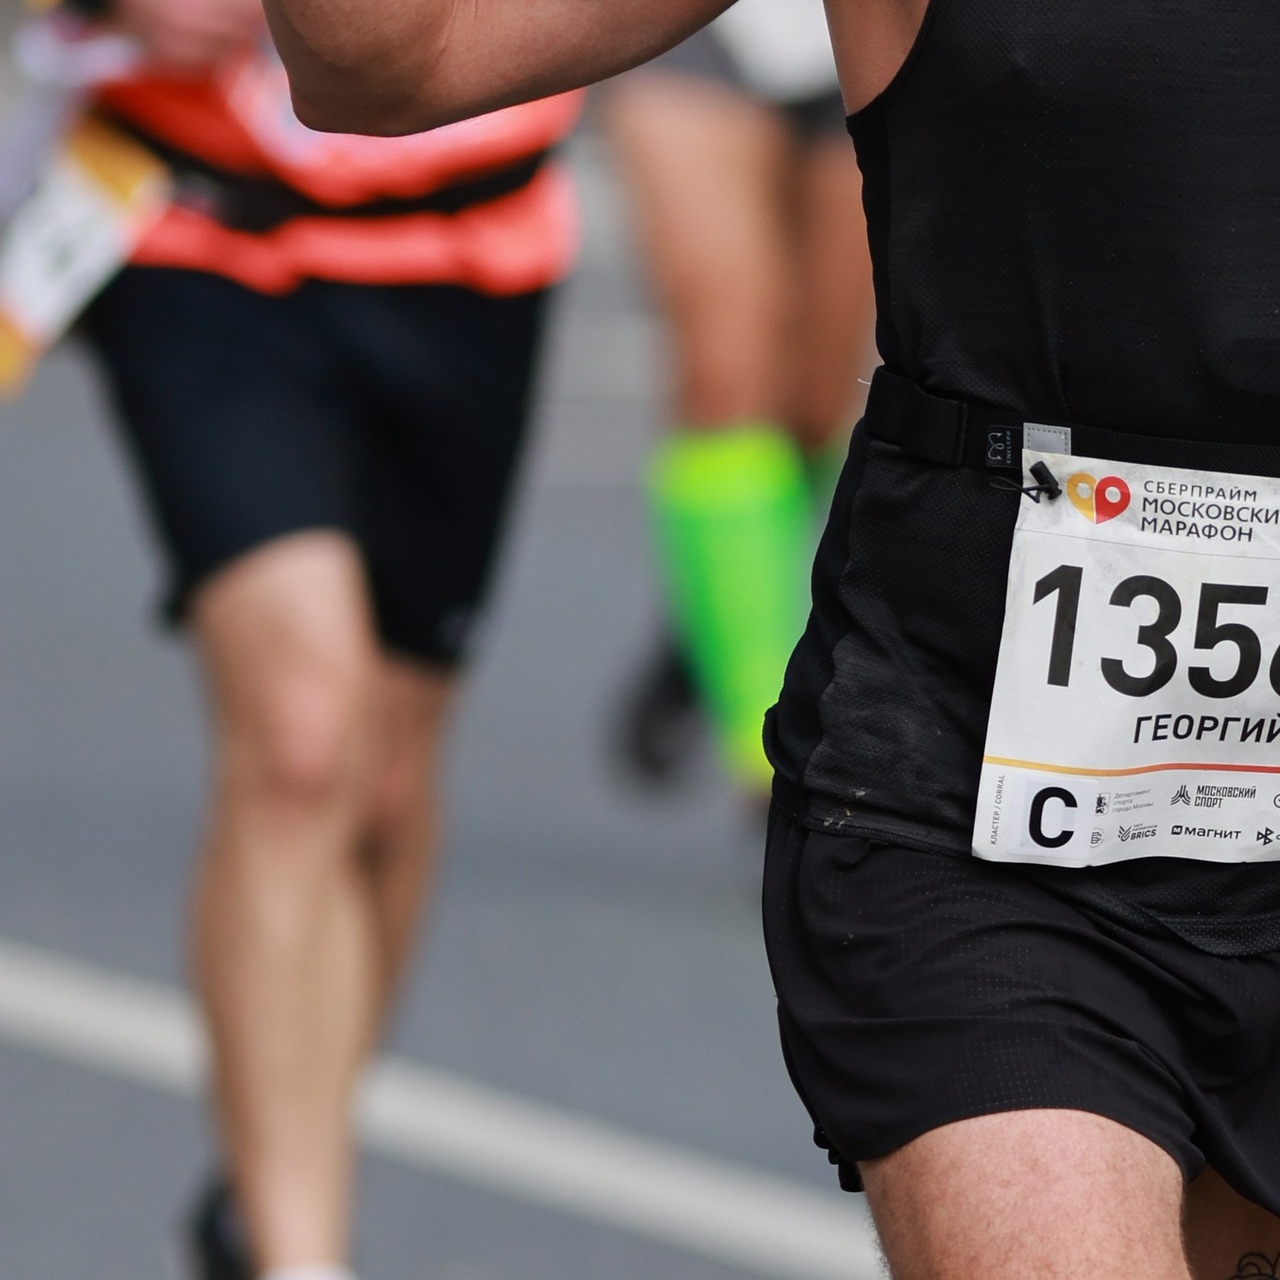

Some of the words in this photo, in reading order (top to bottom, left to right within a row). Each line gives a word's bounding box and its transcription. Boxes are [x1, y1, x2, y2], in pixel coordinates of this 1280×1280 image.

[1143, 480, 1257, 502] СБЕРПРАЙМ
[1141, 517, 1253, 542] МАРАФОН
[995, 774, 1005, 805] CORRAL
[1196, 785, 1257, 799] МОСКОВСКИЙ
[1194, 796, 1223, 809] СПОРТ
[990, 810, 1001, 845] КЛАСТЕР
[1130, 829, 1157, 840] BRICS
[1184, 826, 1242, 840] магнит
